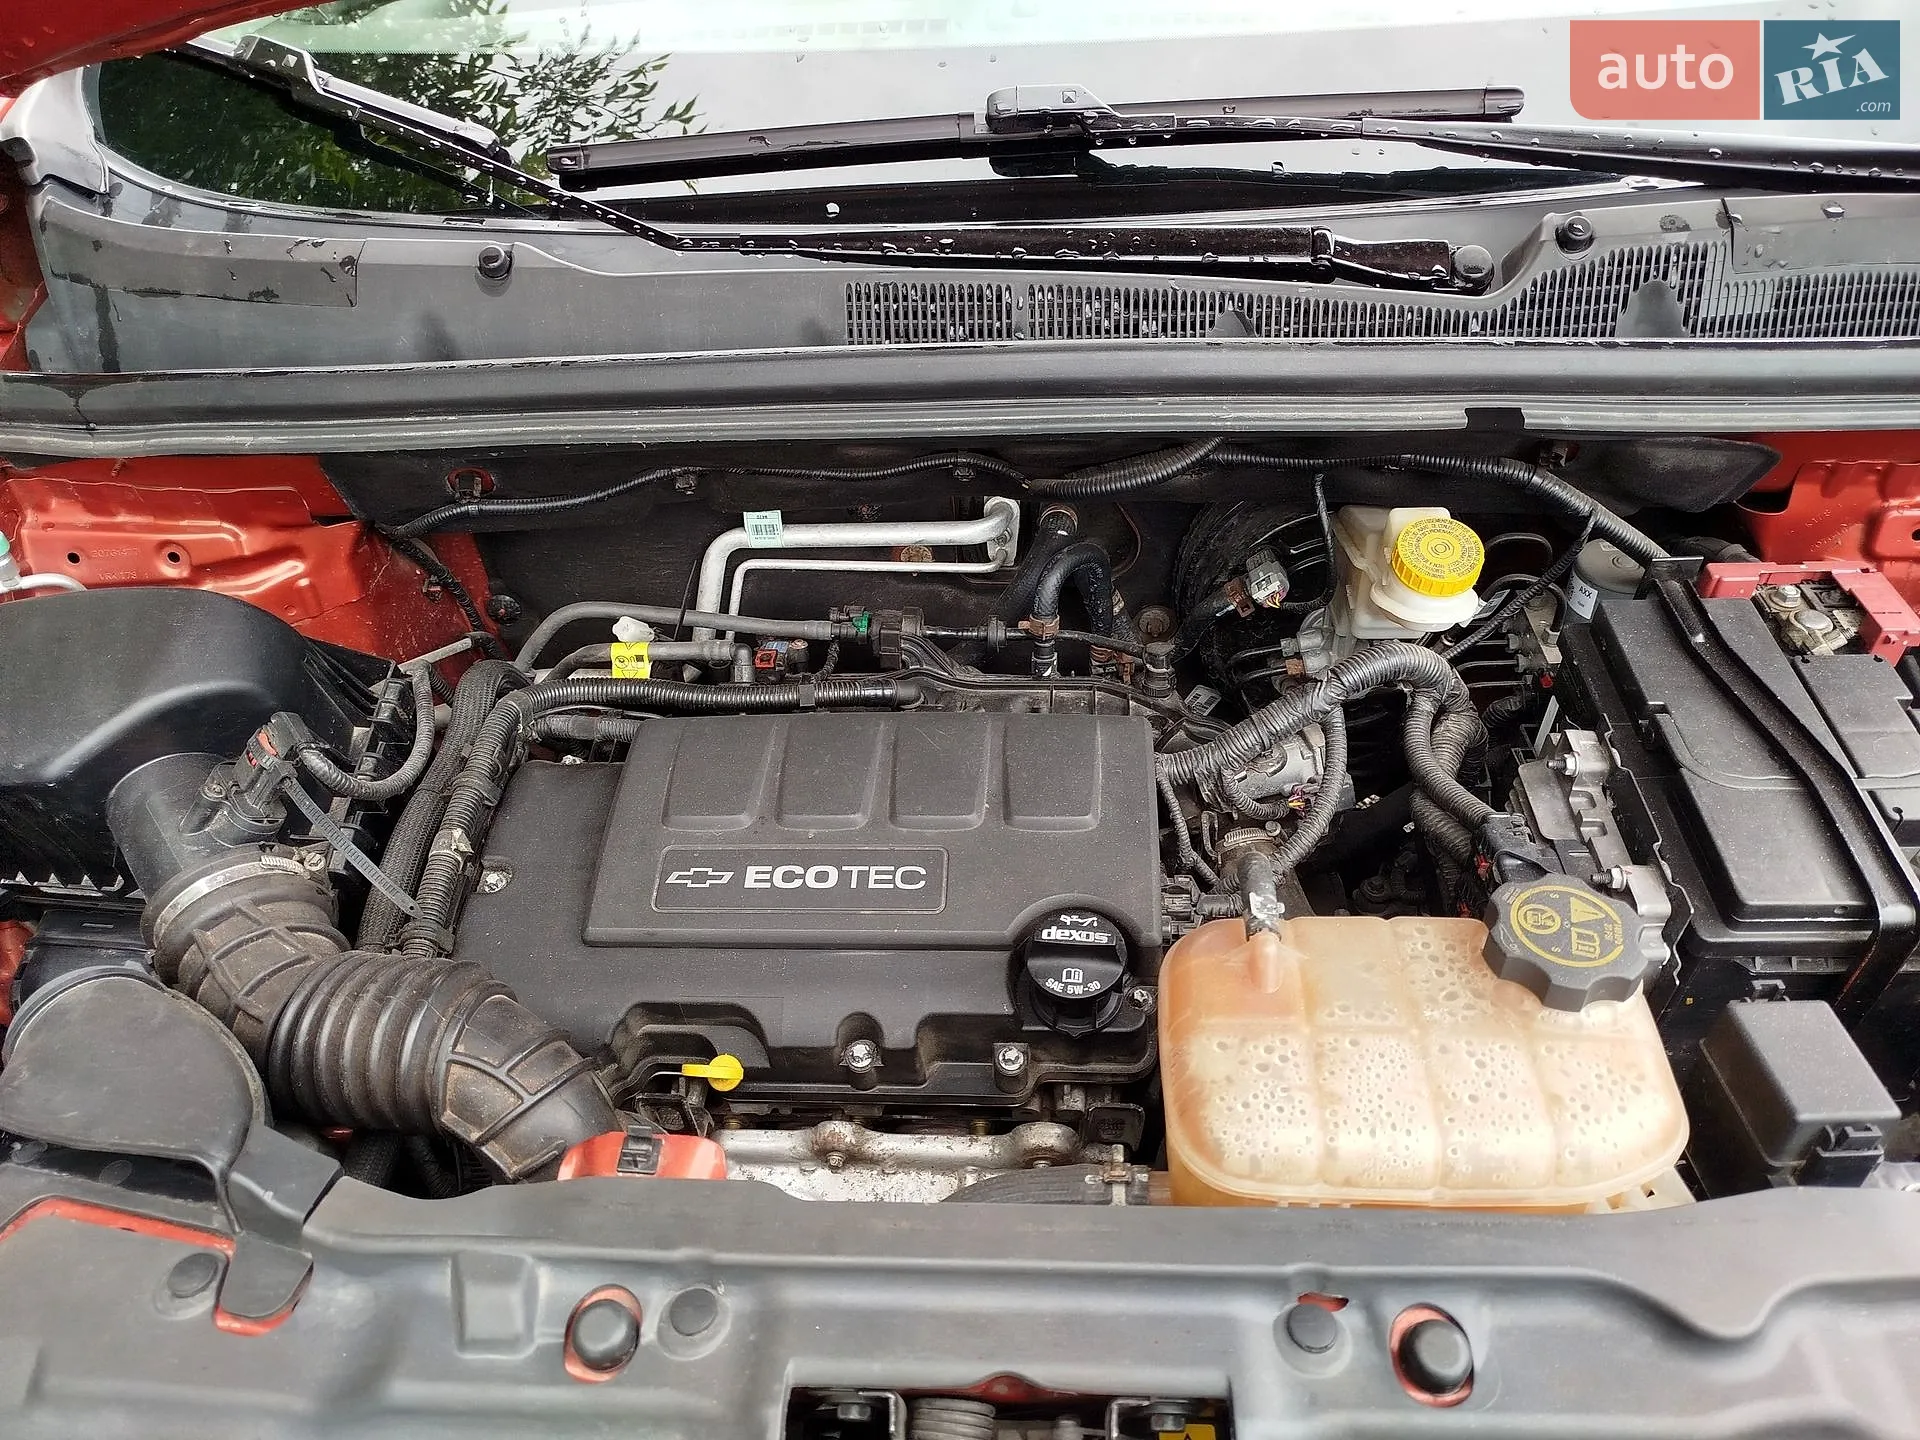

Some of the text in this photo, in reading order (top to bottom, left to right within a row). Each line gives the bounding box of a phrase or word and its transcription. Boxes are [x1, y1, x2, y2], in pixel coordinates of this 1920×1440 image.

[743, 865, 928, 890] ECOTEC
[1041, 926, 1111, 944] dexos
[1045, 977, 1101, 996] SAE 5W-30
